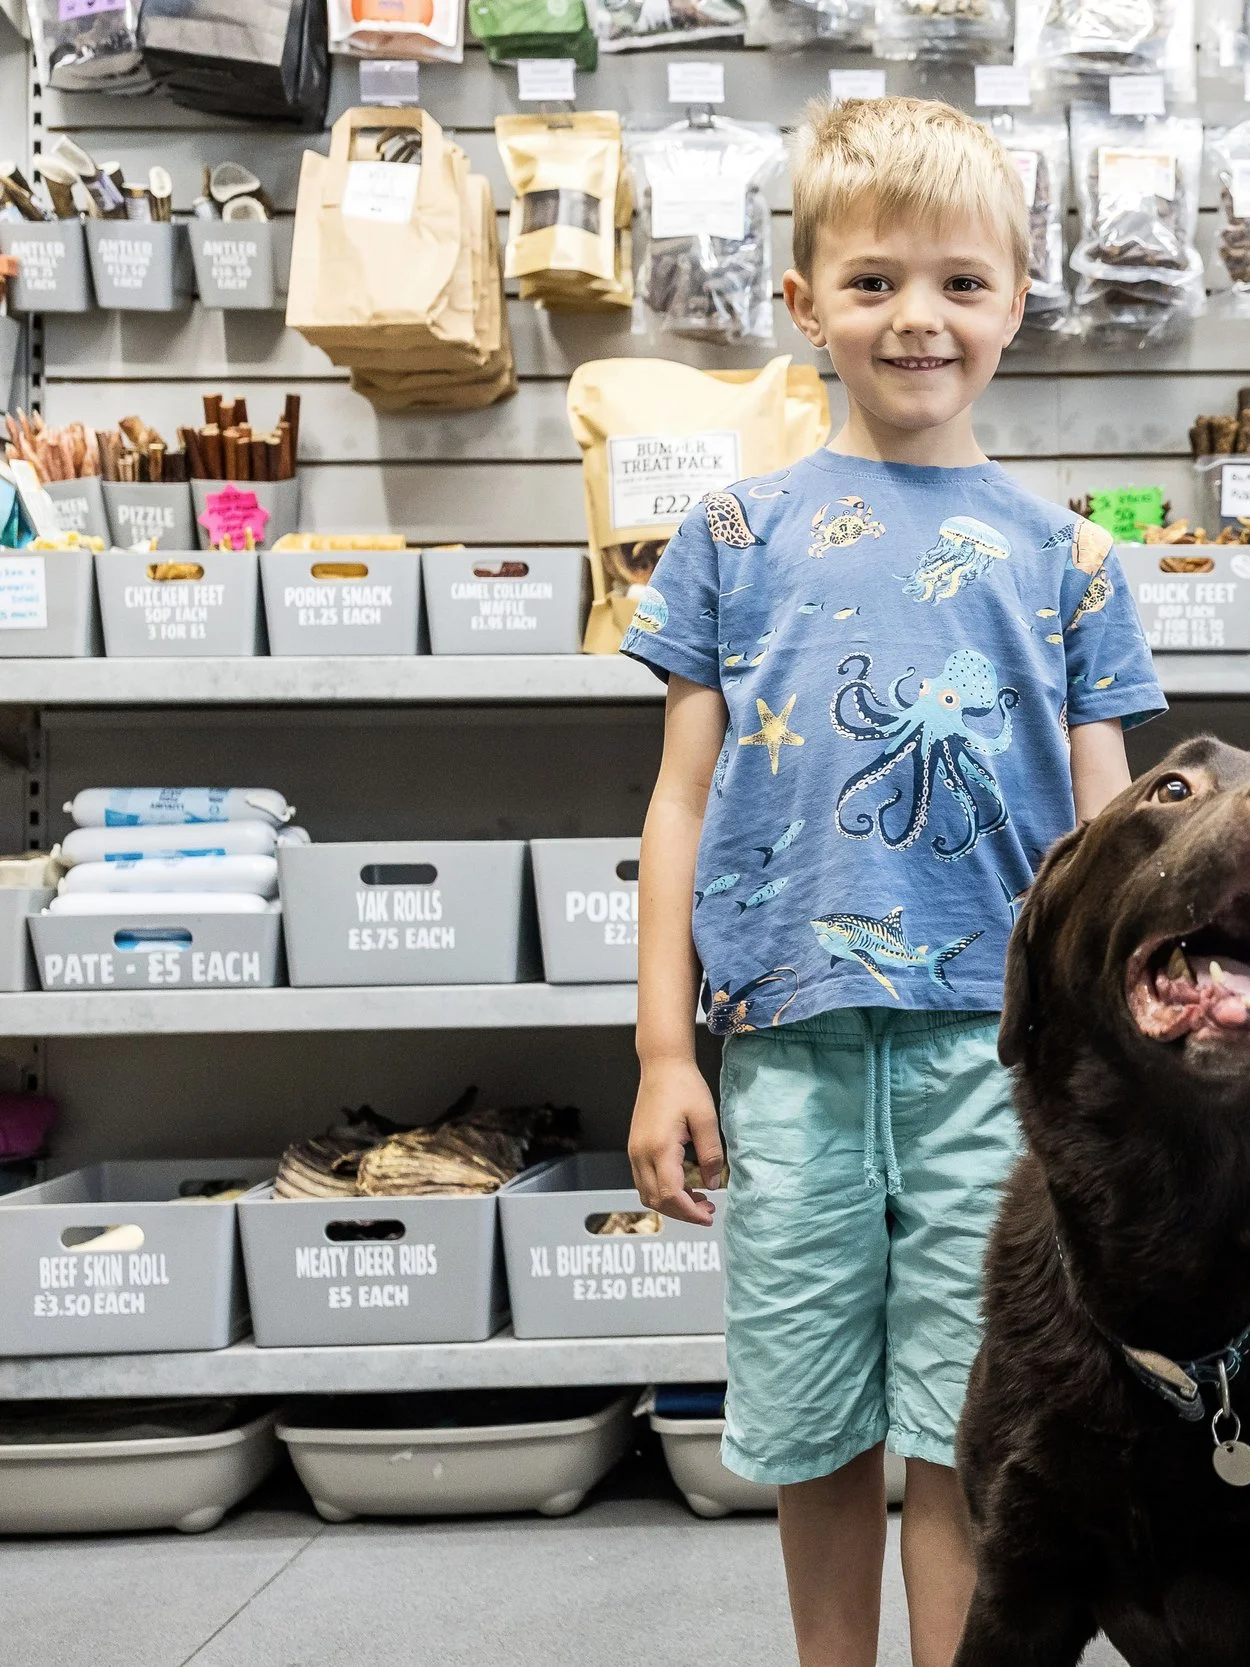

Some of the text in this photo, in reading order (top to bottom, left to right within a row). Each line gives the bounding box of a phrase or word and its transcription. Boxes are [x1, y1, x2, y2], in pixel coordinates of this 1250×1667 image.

[11, 241, 65, 257] ANTLER
[98, 239, 152, 256] ANTLER
[203, 240, 257, 257] ANTLER
[217, 278, 247, 290] EACH
[621, 455, 725, 475] TREAT PACK
[653, 494, 692, 515] £22
[117, 505, 176, 528] PIZZLE
[124, 584, 225, 608] CHICKEN FEET
[284, 585, 392, 607] PORKY SNACK
[451, 582, 553, 600] CAMEL COLLAGEN
[1138, 582, 1238, 603] DUCK FEET
[176, 607, 208, 623] EACH
[343, 607, 381, 625] EACH
[480, 600, 526, 616] WAFFLE
[148, 624, 156, 640] 3
[161, 623, 186, 640] FOR
[506, 616, 537, 630] EACH
[356, 889, 442, 922] YAK ROLLS
[348, 926, 456, 951] £5.75 EACH
[44, 951, 260, 985] PATE £5 EACH
[295, 1243, 438, 1279] MEATY DEER RIBS
[530, 1241, 722, 1277] XL BUFFALO TRACHEA
[39, 1253, 170, 1289] BEEF SKIN ROLL
[328, 1284, 409, 1308] £5 EACH
[573, 1276, 681, 1300] £2.50 EACH
[33, 1292, 145, 1317] £3.50 EACH
